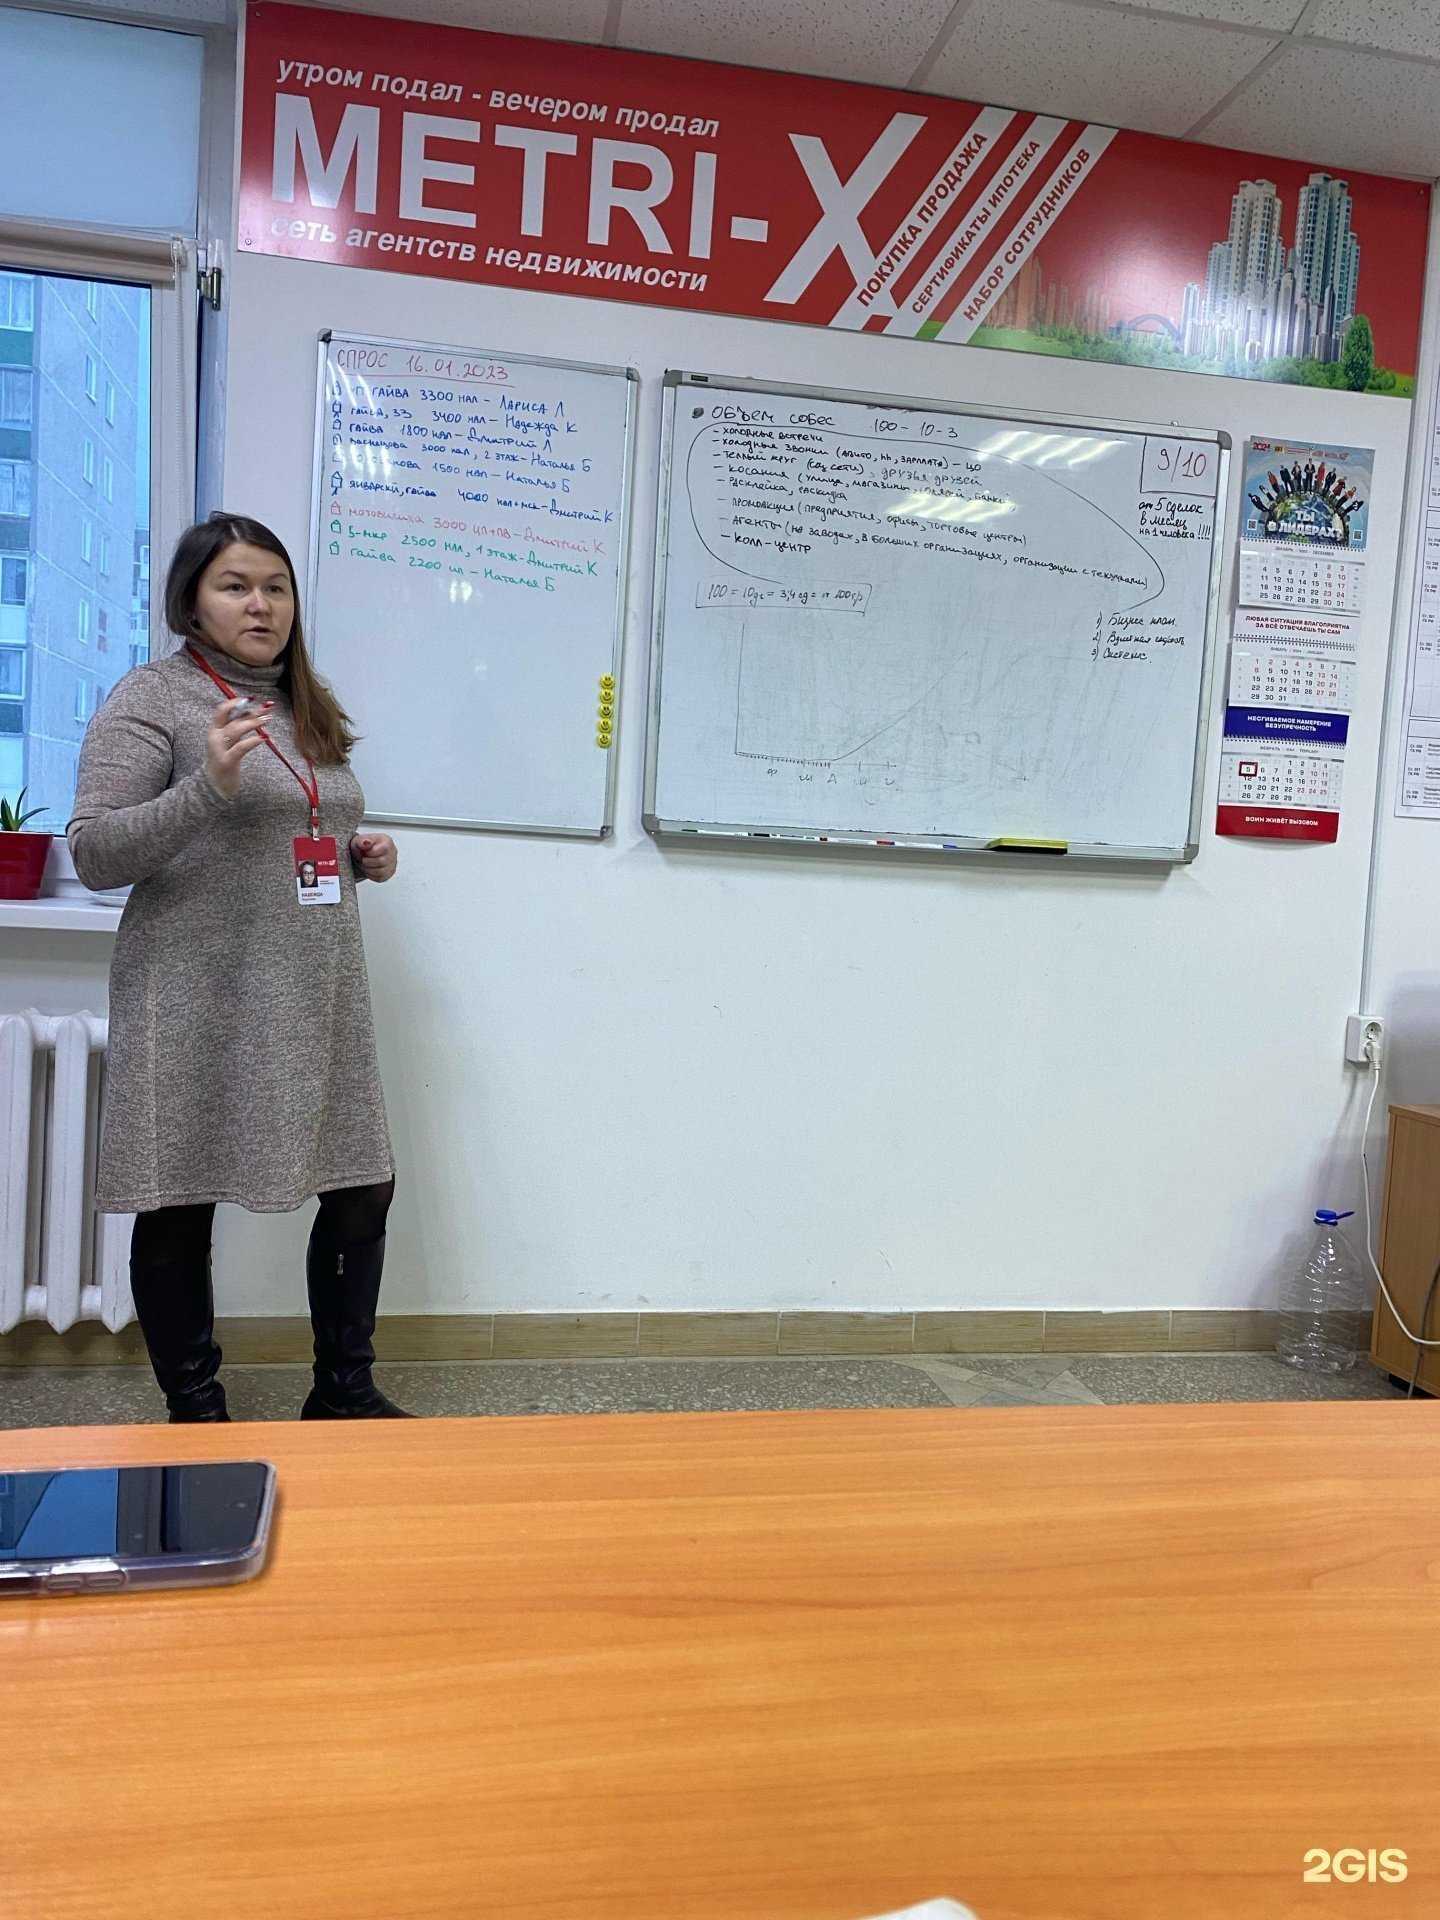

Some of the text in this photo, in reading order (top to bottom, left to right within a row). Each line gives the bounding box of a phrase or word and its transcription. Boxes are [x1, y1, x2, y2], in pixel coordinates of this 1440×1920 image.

[276, 58, 364, 87] утром
[371, 74, 463, 102] подал
[489, 90, 608, 122] вечером
[615, 106, 720, 137] продал
[271, 92, 929, 316] METRI-X
[856, 131, 989, 307] ПОКУПКА ПРОДАЖА
[912, 139, 1041, 314] СЕРТИФИКАТЫ ИПОТЕКА
[962, 147, 1091, 321] НАБОР СОТРУДНИКОВ
[271, 216, 708, 291] сеть агентств недвижимости
[337, 349, 388, 369] СПРОС
[420, 389, 453, 401] 3300
[1158, 446, 1206, 482] 9/10
[1154, 497, 1167, 510] 5
[1296, 511, 1315, 521] ТЫ
[1152, 528, 1158, 536] 1
[1270, 617, 1303, 625] СИТУАЦИЯ
[1304, 620, 1350, 630] БЛАГОПРИЯТНА
[1279, 625, 1317, 633] ОТВЕЧАЕШЬ
[1265, 722, 1317, 732] БЕЗУПРЕЧНОСТЬ
[1297, 718, 1332, 727] НАМЕРЕНИЕ
